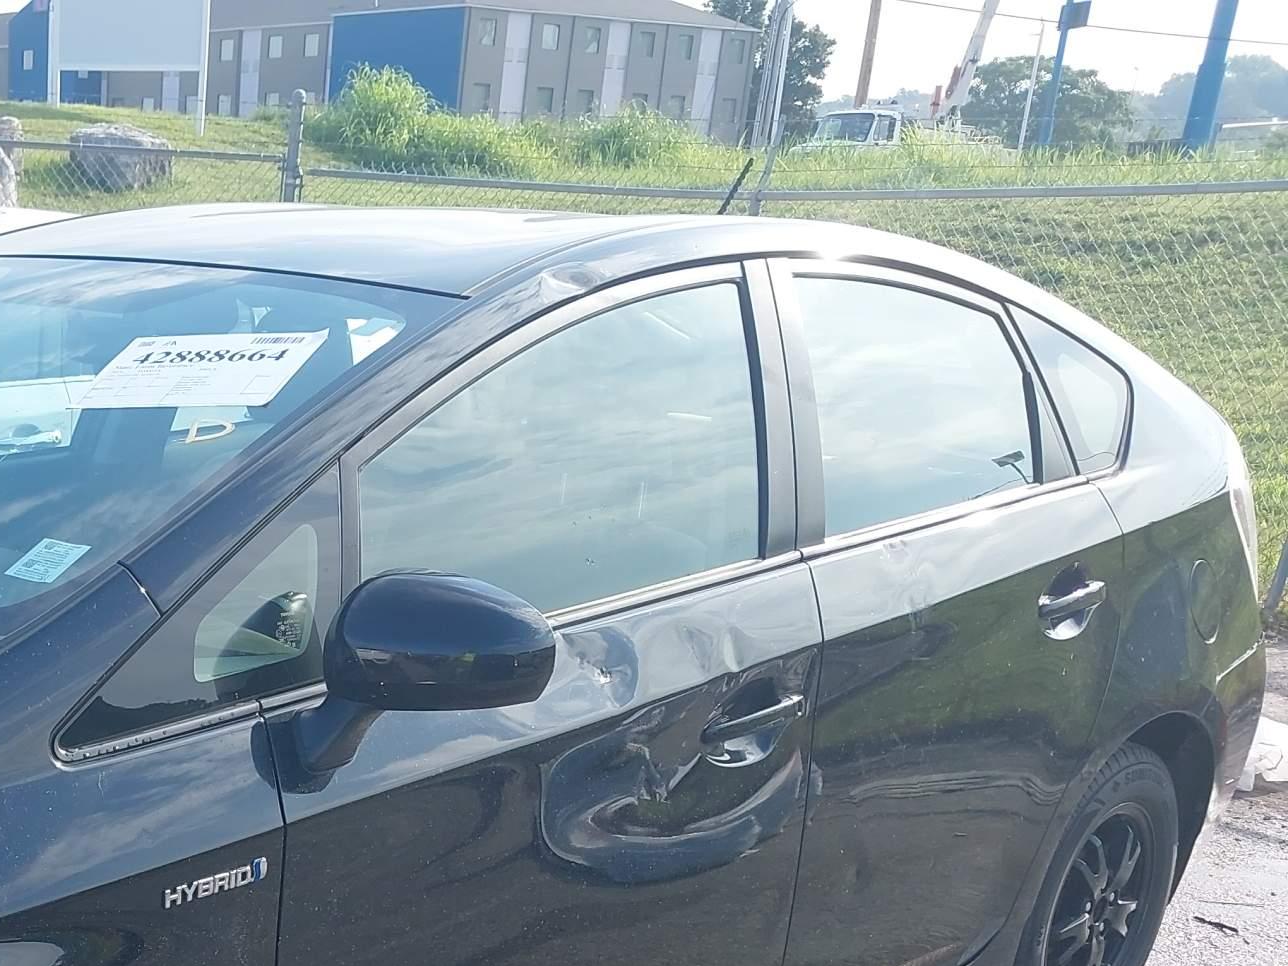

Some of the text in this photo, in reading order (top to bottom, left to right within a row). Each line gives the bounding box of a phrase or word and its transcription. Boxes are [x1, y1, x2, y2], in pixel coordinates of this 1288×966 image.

[132, 348, 289, 364] 42888664
[184, 418, 235, 444] D
[164, 865, 254, 909] HYBRID
